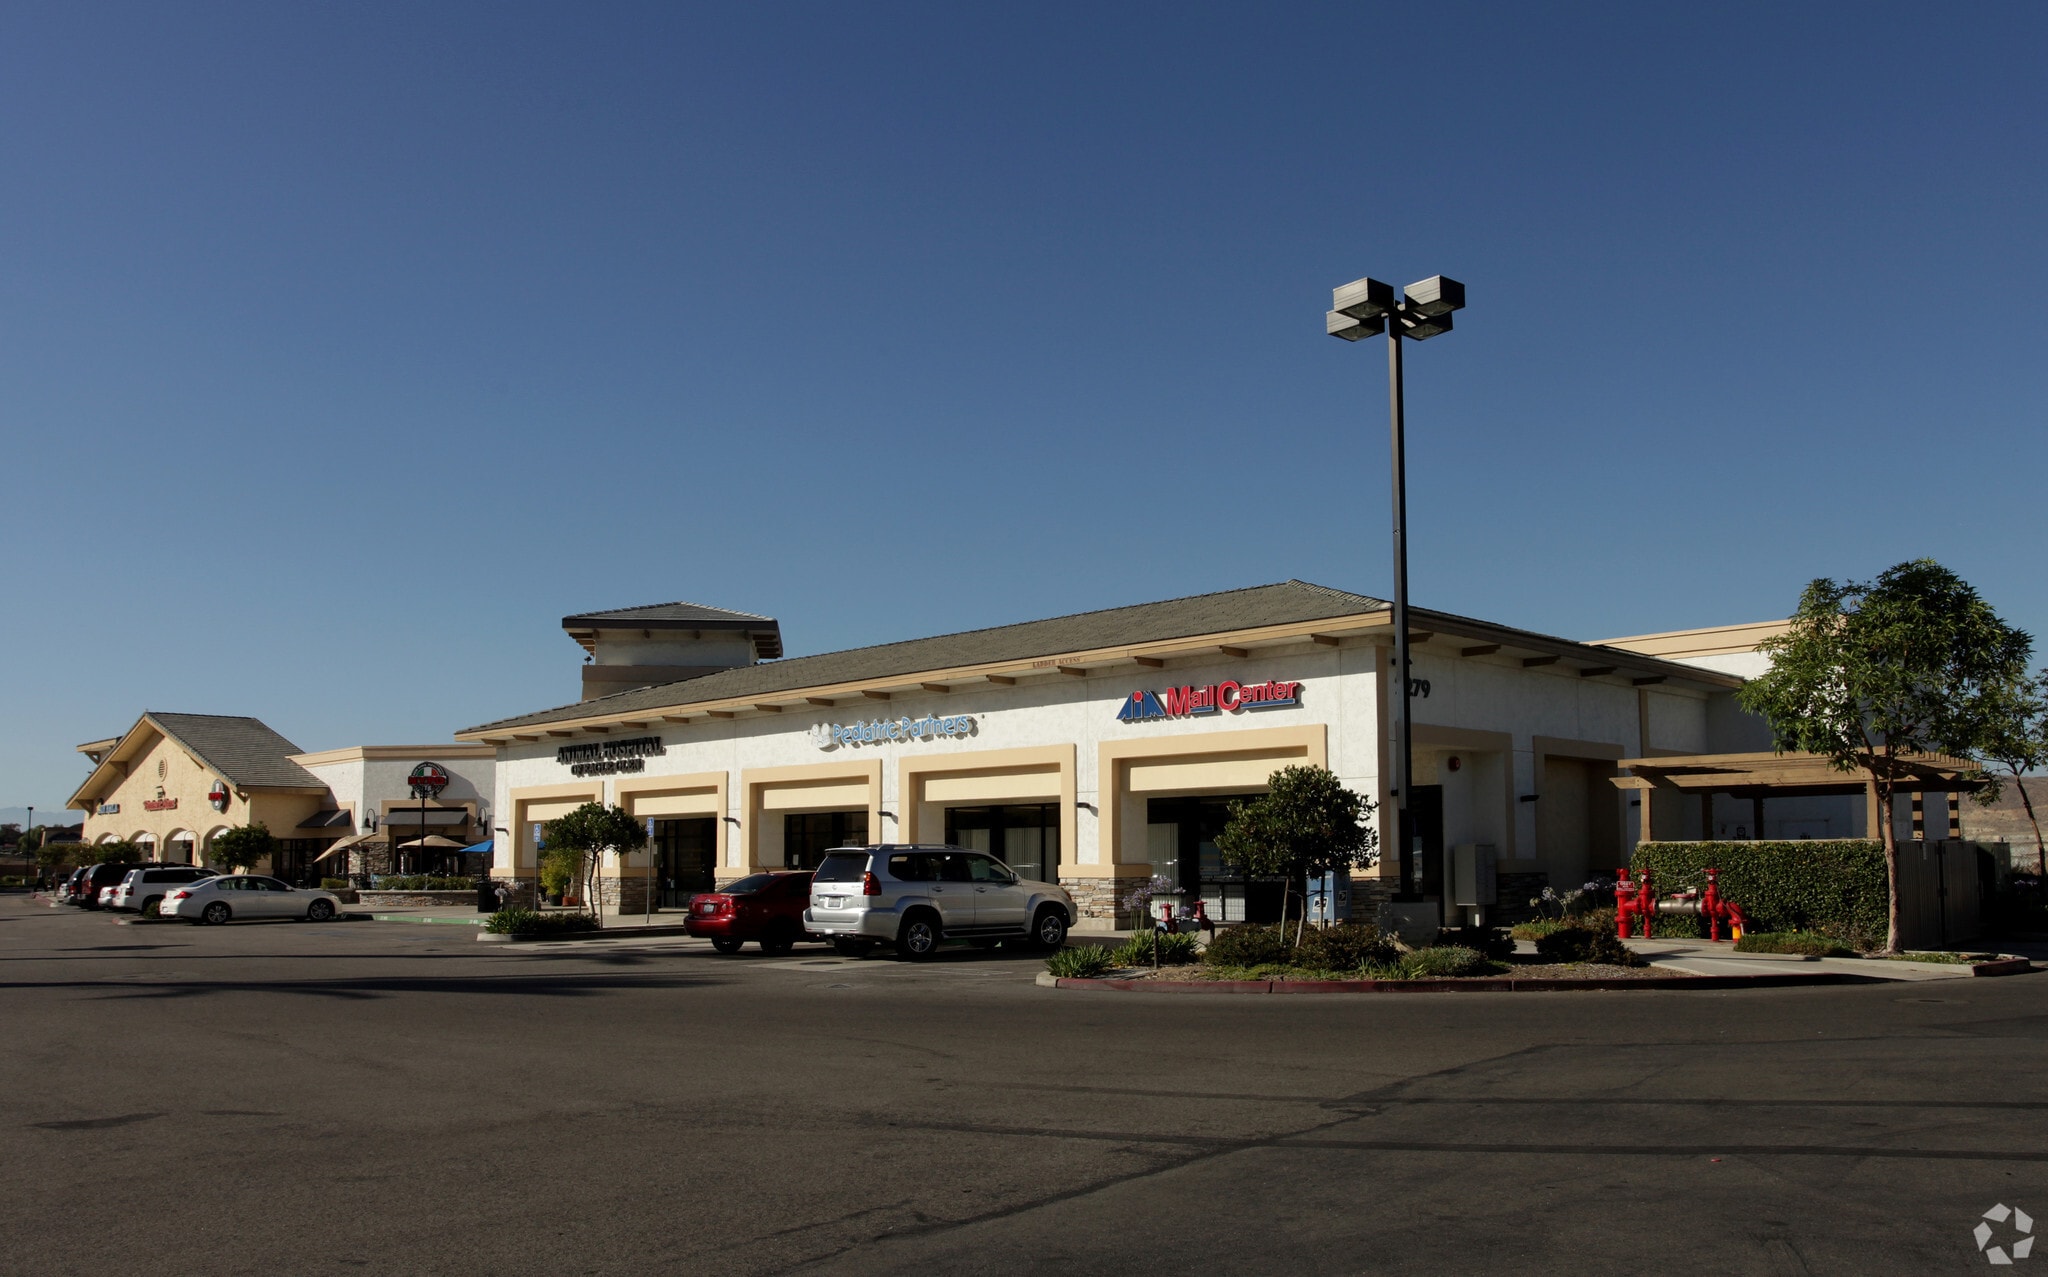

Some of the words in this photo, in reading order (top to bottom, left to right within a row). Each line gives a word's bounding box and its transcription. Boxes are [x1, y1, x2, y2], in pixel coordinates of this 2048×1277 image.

[1059, 656, 1080, 665] ACCESS
[1166, 684, 1214, 716] Mail
[1217, 680, 1298, 711] Center
[832, 719, 898, 744] Pediatric
[901, 713, 969, 738] Partners
[557, 743, 600, 764] ANIMAL
[603, 736, 663, 758] HOSPITAL
[571, 764, 583, 777] OF
[584, 761, 615, 775] EAGLE
[616, 758, 643, 773] GLEN
